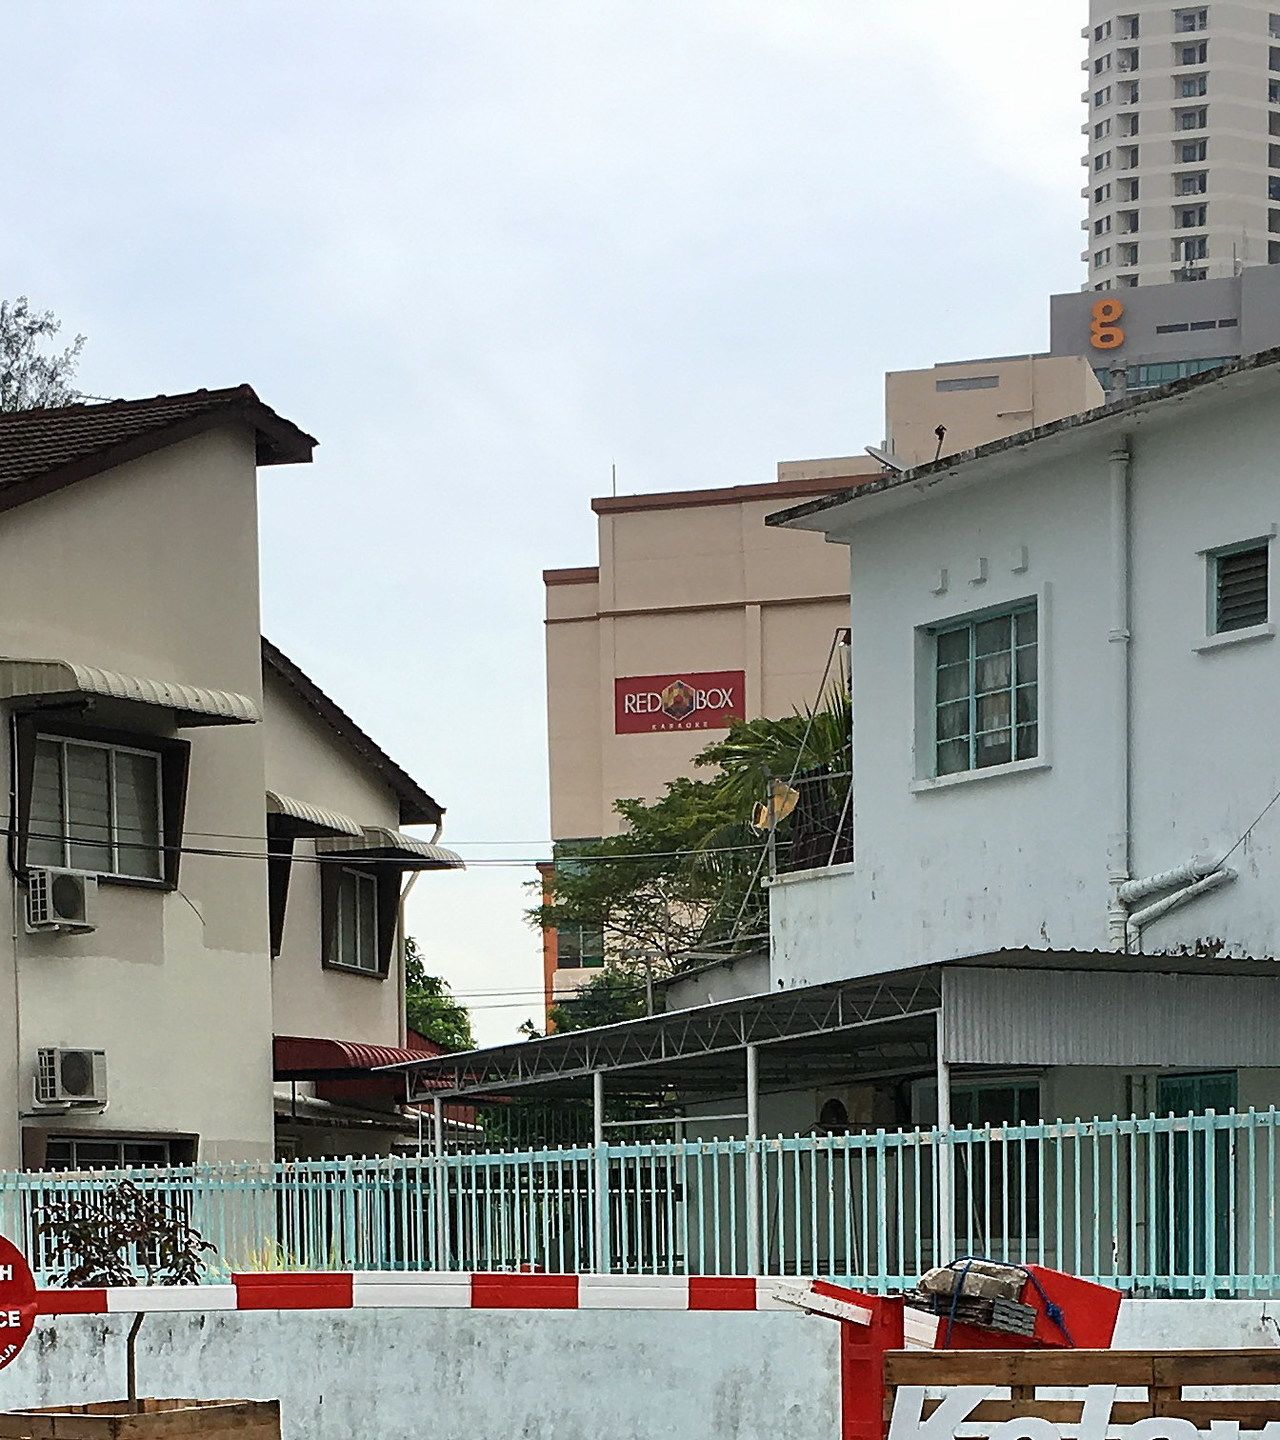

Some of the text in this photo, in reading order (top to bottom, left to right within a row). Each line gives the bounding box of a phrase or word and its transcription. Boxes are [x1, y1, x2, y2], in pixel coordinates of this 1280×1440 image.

[624, 687, 734, 714] RED BOX
[651, 721, 708, 731] KARAOKE
